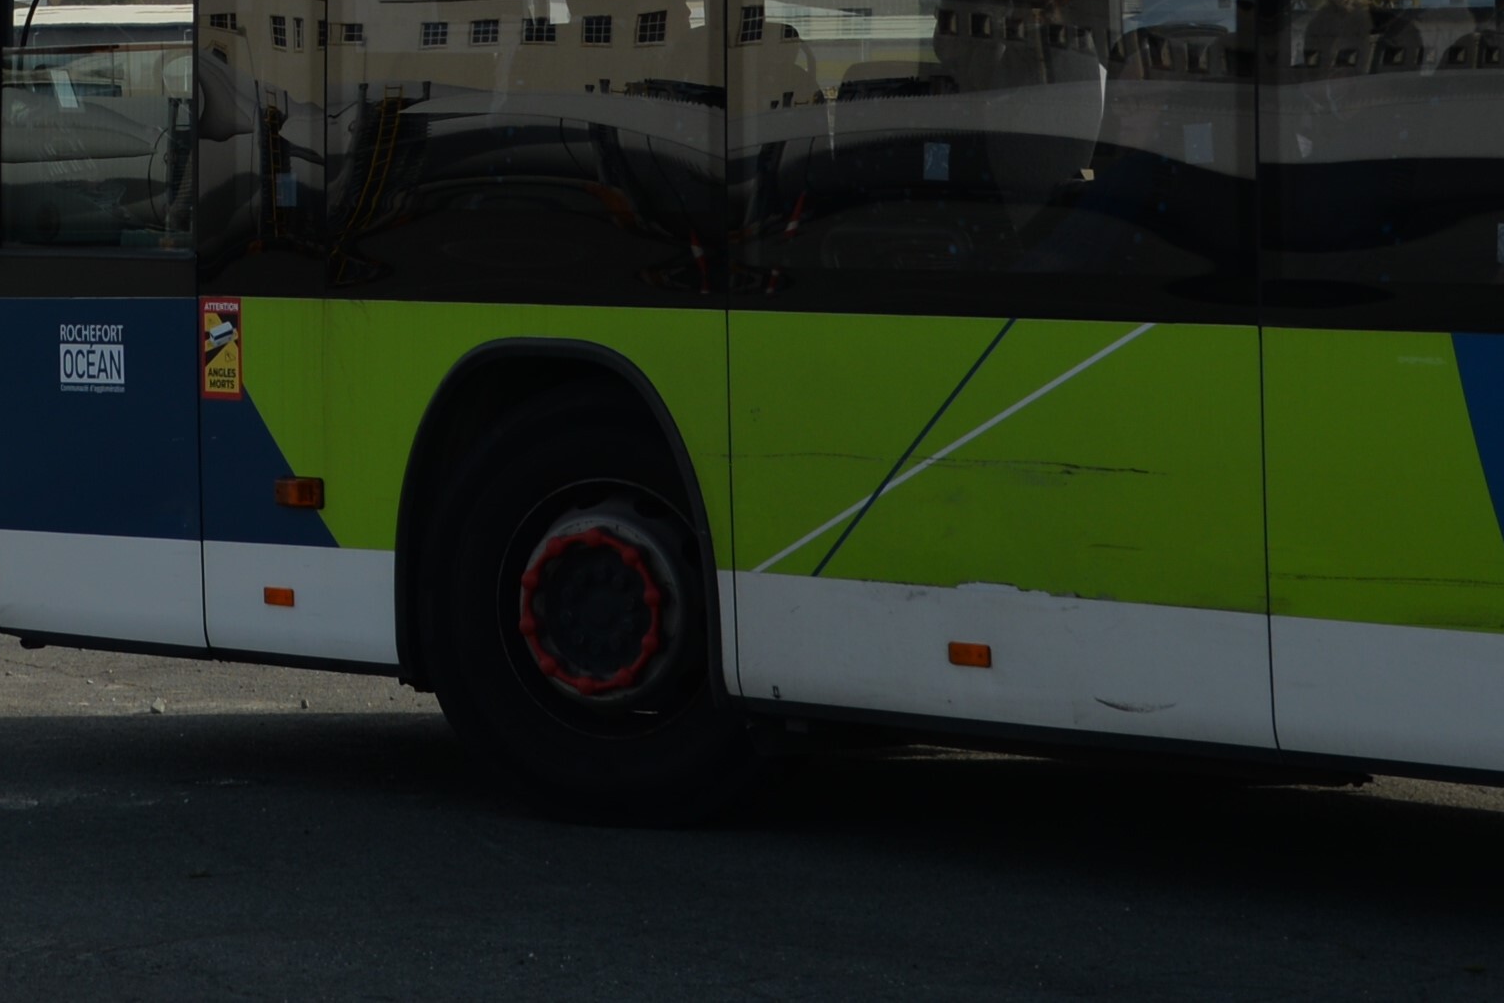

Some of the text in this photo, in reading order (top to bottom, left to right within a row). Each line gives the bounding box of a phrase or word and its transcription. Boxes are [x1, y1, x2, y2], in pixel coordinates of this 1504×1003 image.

[204, 302, 239, 311] ATTENTION
[59, 324, 124, 342] ROCHEFORT
[63, 344, 122, 380] OCÉAN
[208, 367, 237, 378] ANGLES
[209, 379, 235, 389] MORTS
